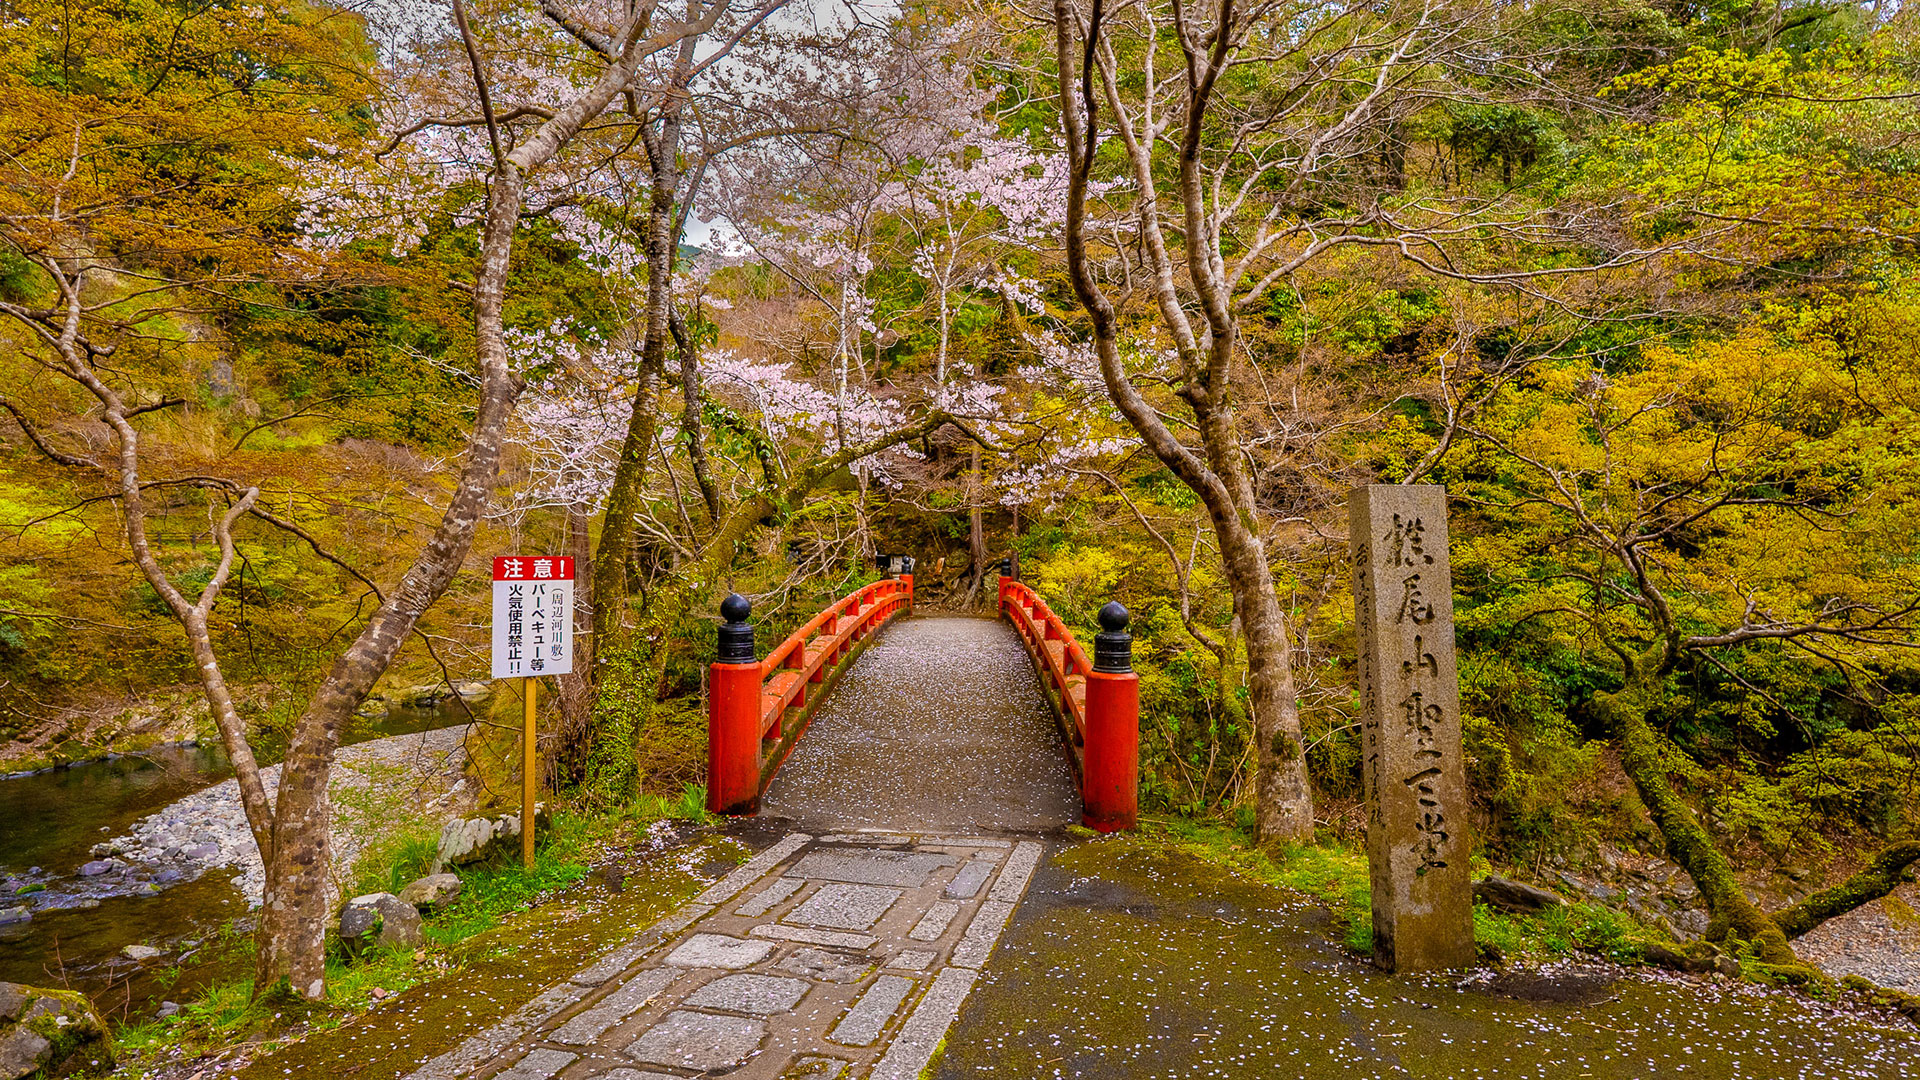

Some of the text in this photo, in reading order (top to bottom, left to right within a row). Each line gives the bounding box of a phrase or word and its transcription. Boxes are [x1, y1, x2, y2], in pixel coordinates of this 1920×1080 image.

[503, 558, 565, 578] 注意!
[508, 584, 523, 674] 火気使用禁止!!
[530, 583, 546, 672] バーベキュー等
[551, 588, 565, 661] (周辺河川敷)
